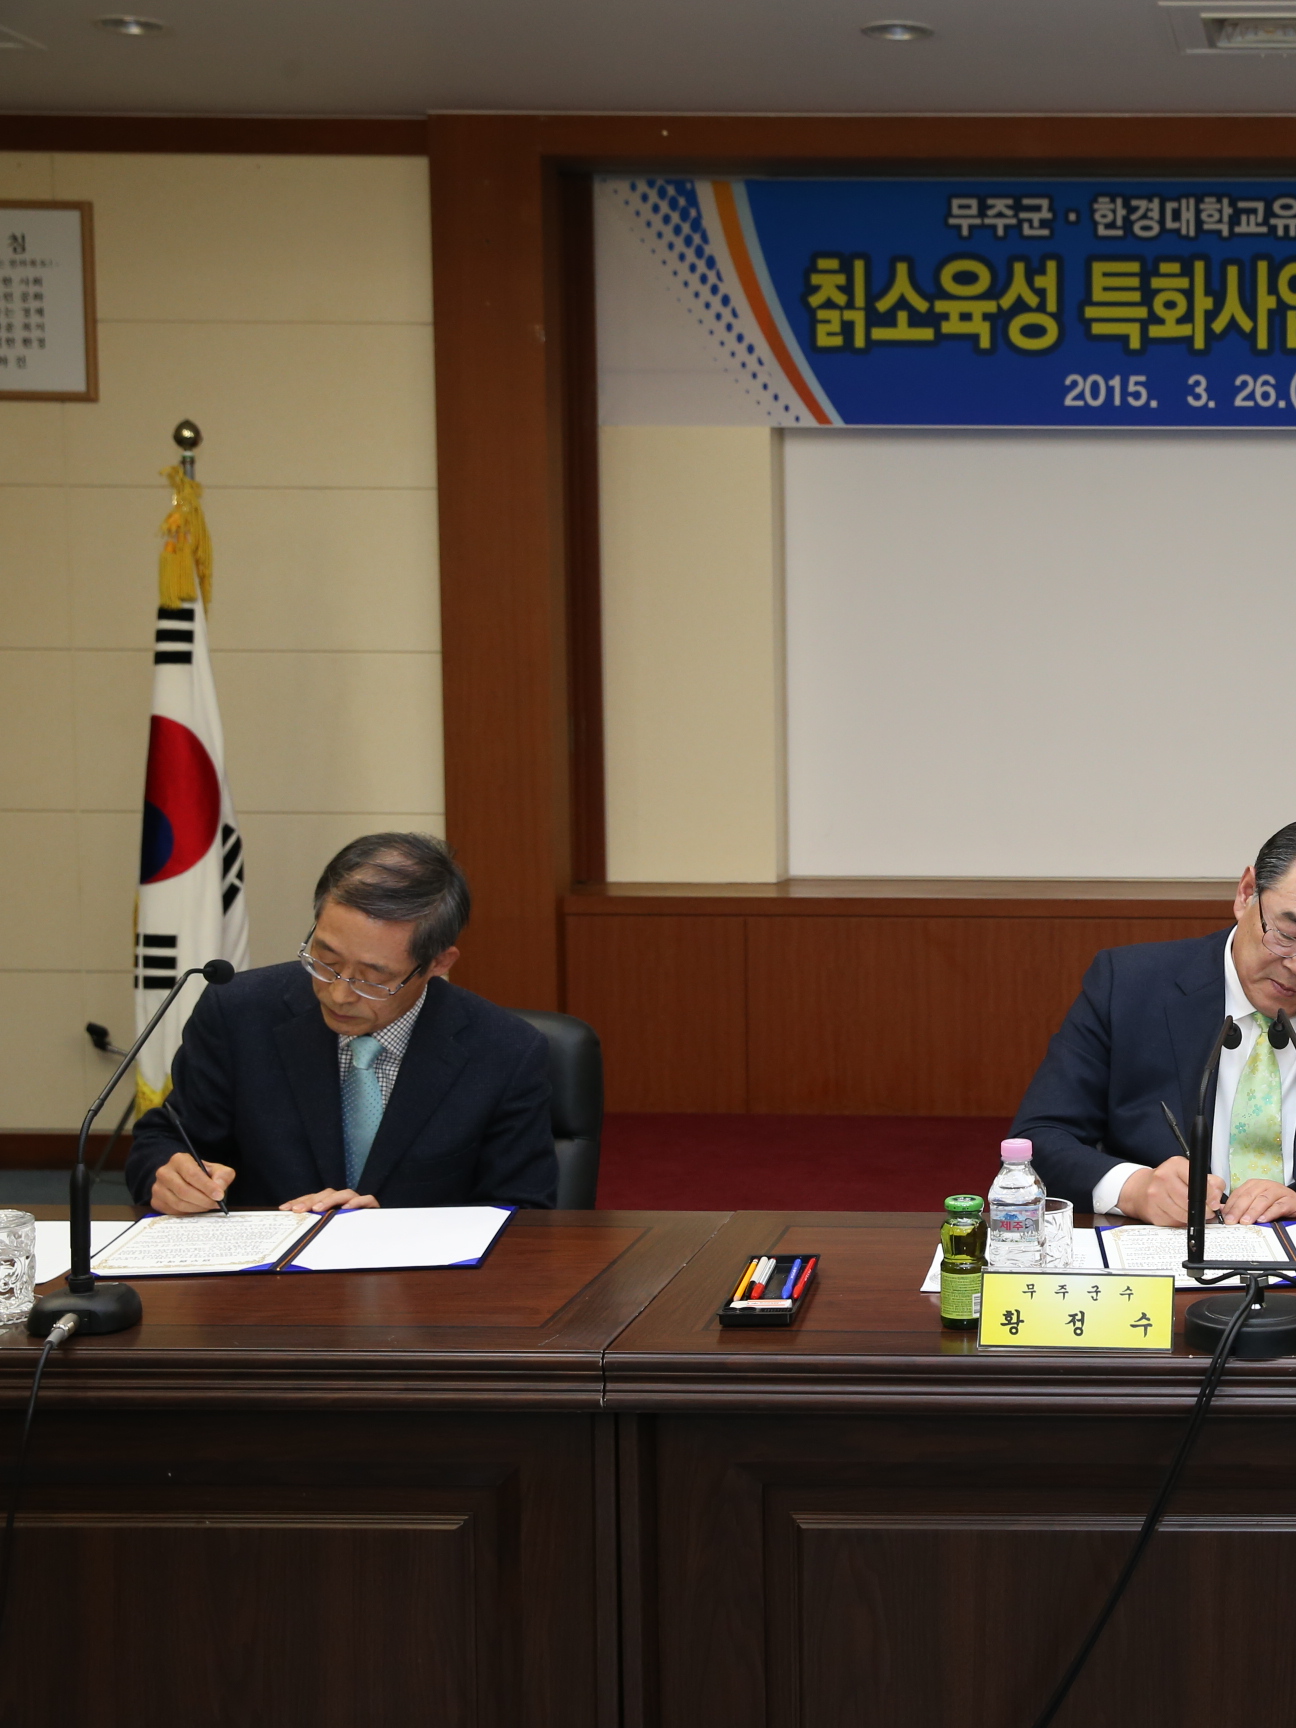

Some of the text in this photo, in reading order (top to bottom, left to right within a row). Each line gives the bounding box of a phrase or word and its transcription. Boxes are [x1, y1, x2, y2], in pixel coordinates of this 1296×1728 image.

[947, 196, 1054, 237] 무주군
[806, 257, 1060, 350] 칡소육성
[1063, 373, 1158, 409] 2015.
[1186, 373, 1216, 409] 3.
[1000, 1220, 1024, 1232] 제주
